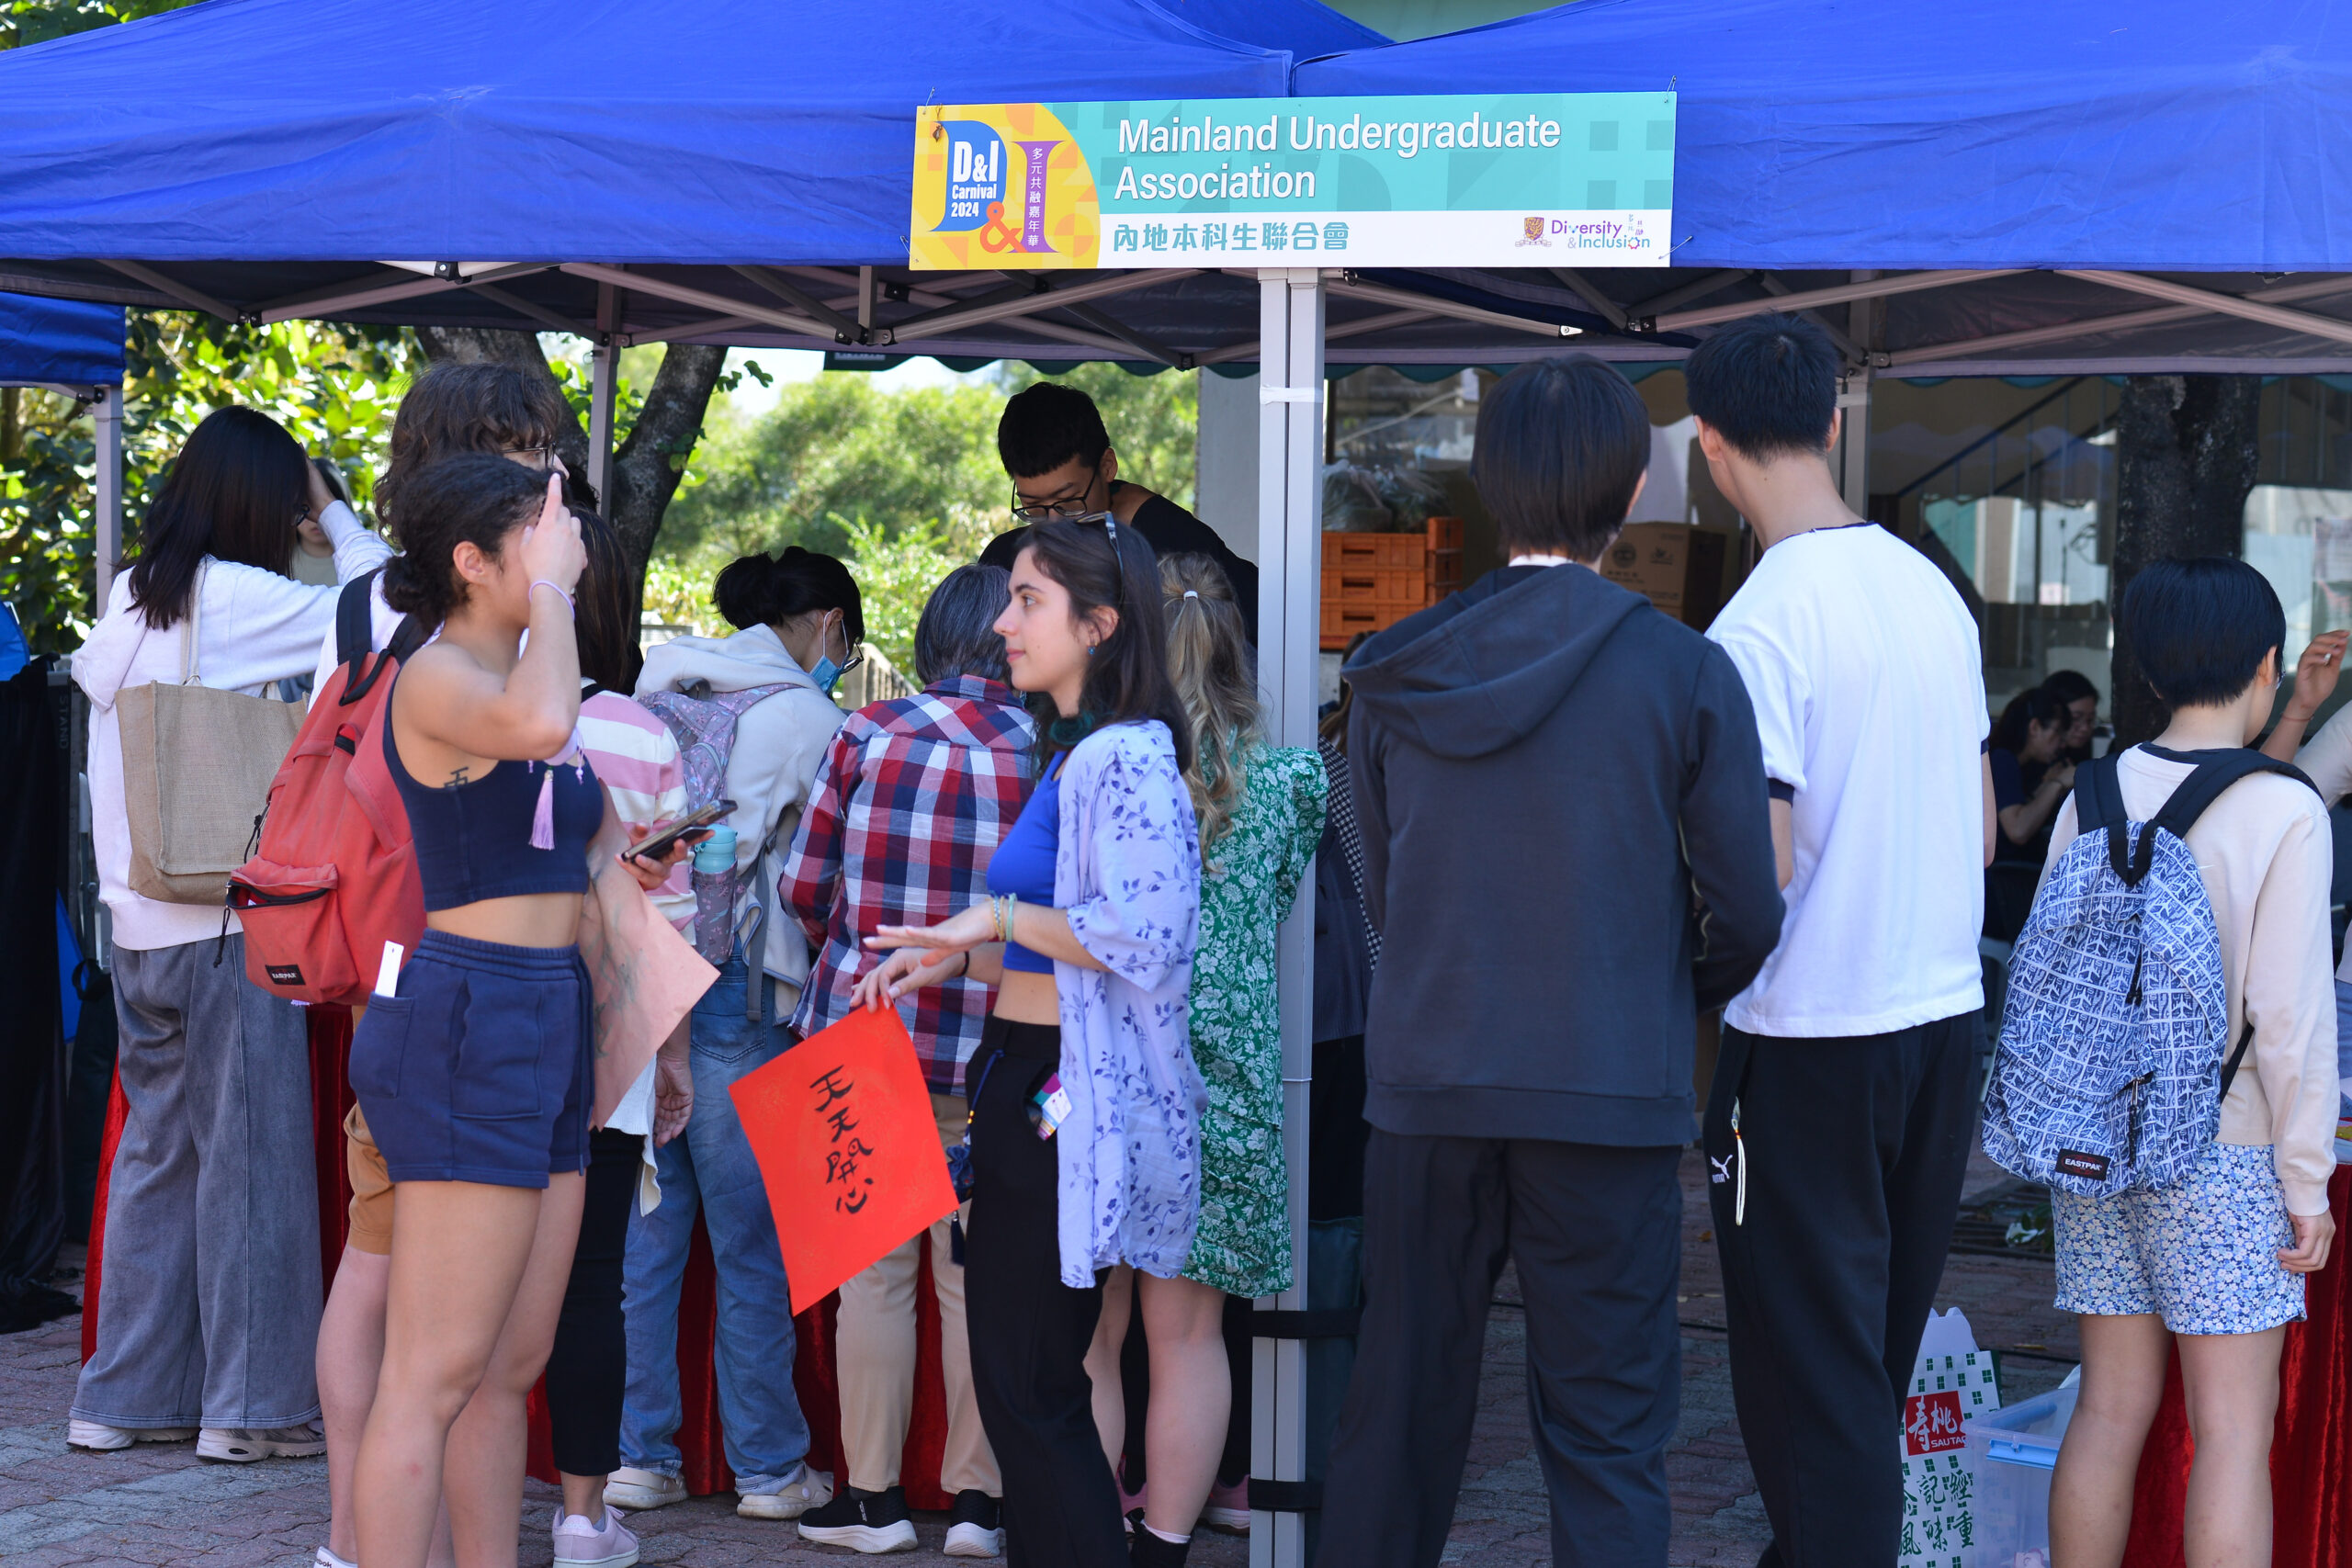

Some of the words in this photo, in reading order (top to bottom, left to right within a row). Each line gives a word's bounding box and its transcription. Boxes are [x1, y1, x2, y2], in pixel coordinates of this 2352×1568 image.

[1118, 114, 1278, 153] Mainland
[1289, 111, 1561, 158] Undergraduate
[953, 141, 1000, 182] D&I
[952, 184, 997, 200] Carnival
[1027, 147, 1044, 247] 多元共融嘉年華
[1114, 162, 1316, 200] Association
[951, 202, 979, 218] 2024
[1114, 221, 1350, 252] 內地本科生聯合會
[1551, 220, 1623, 239] Diversity
[809, 1064, 875, 1214] 天天開心
[2064, 1157, 2103, 1172] EASTPAK
